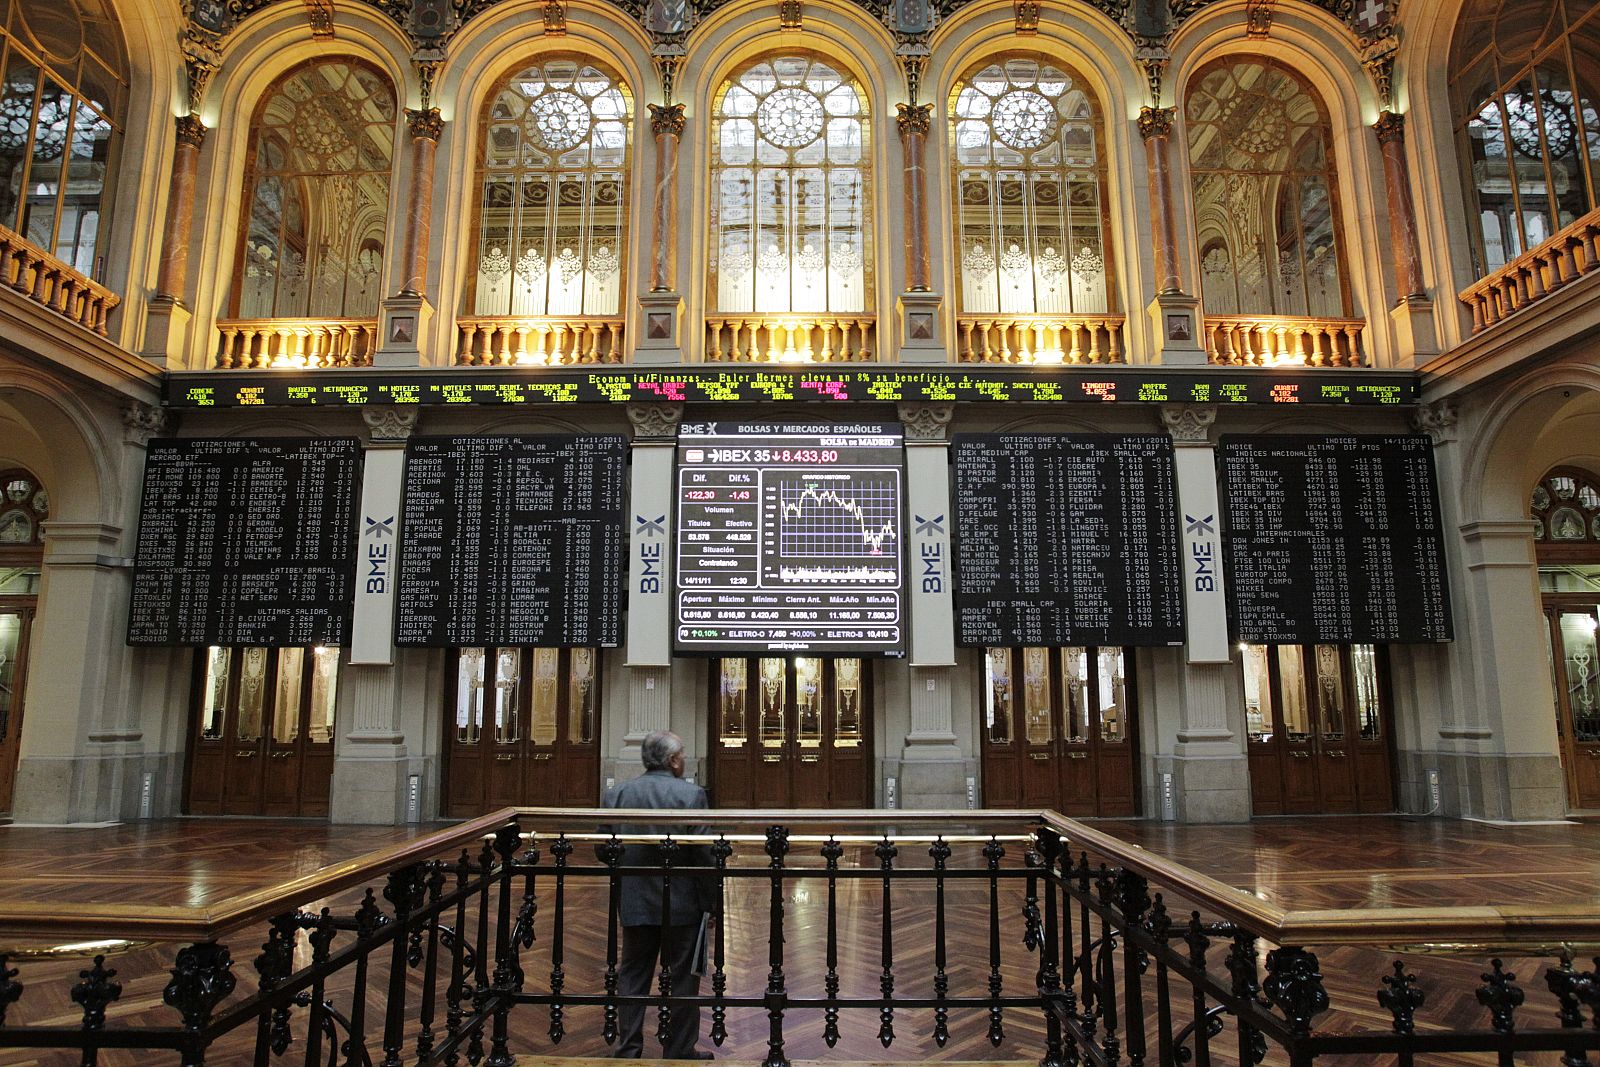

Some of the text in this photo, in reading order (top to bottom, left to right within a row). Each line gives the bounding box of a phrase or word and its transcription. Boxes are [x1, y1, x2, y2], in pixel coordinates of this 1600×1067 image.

[719, 373, 749, 382] Euler
[757, 373, 794, 382] Hermes
[801, 373, 831, 382] eleva
[839, 373, 850, 382] un
[858, 373, 869, 381] 8%
[877, 373, 888, 381] su
[896, 373, 949, 382] beneficio
[681, 425, 704, 433] BME
[834, 425, 882, 433] ESPAÑOLES
[719, 450, 838, 463] IBEX 35 8.433,80
[693, 474, 750, 482] Dif. Dif.%
[685, 491, 749, 500] -122,30 -1,43
[699, 559, 738, 567] Contratando
[1193, 542, 1213, 592] BME
[367, 544, 387, 593] BME
[641, 543, 659, 593] BME
[922, 543, 941, 593] BME
[796, 630, 816, 638] 0,00%
[867, 631, 888, 639] 10,410
